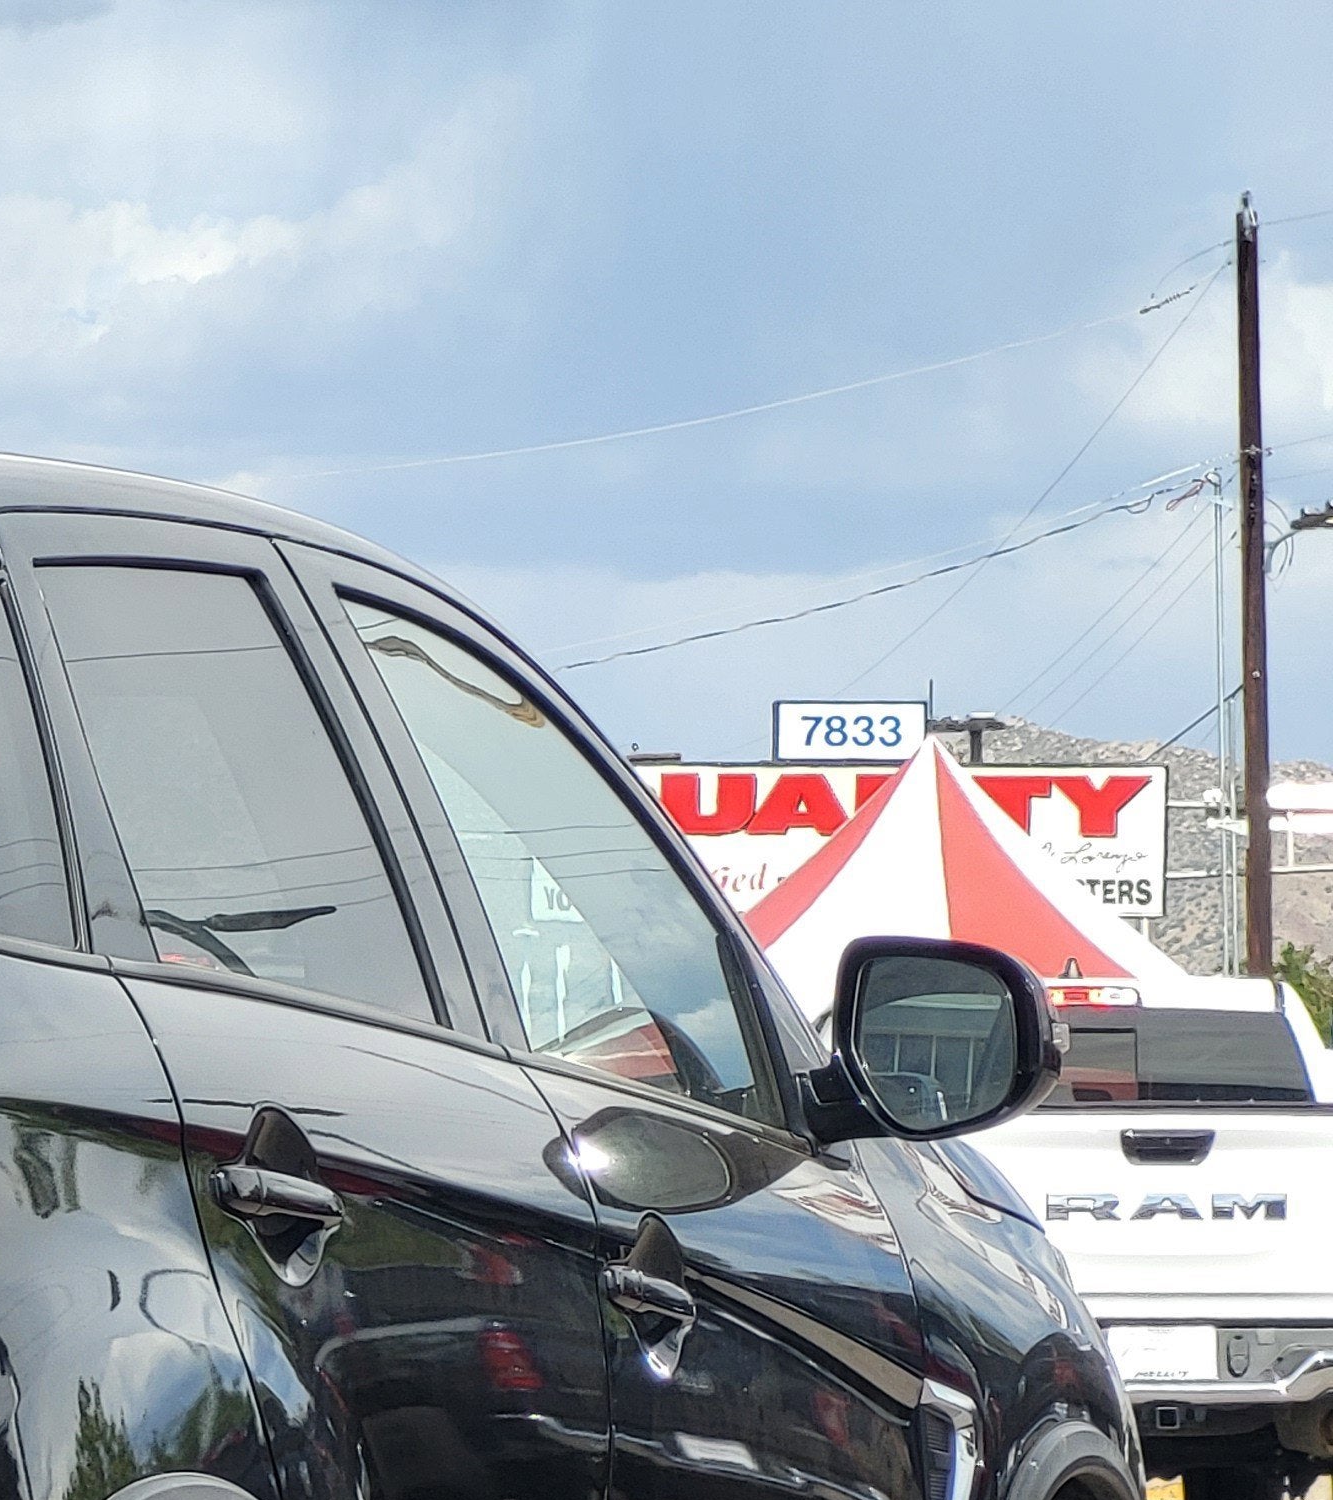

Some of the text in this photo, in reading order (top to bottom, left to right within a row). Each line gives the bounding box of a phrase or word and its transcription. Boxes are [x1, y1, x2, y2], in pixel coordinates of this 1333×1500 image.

[800, 714, 903, 747] 7833
[658, 772, 1152, 838] UATY
[1076, 878, 1153, 906] TERS
[1045, 1192, 1288, 1221] RAM
